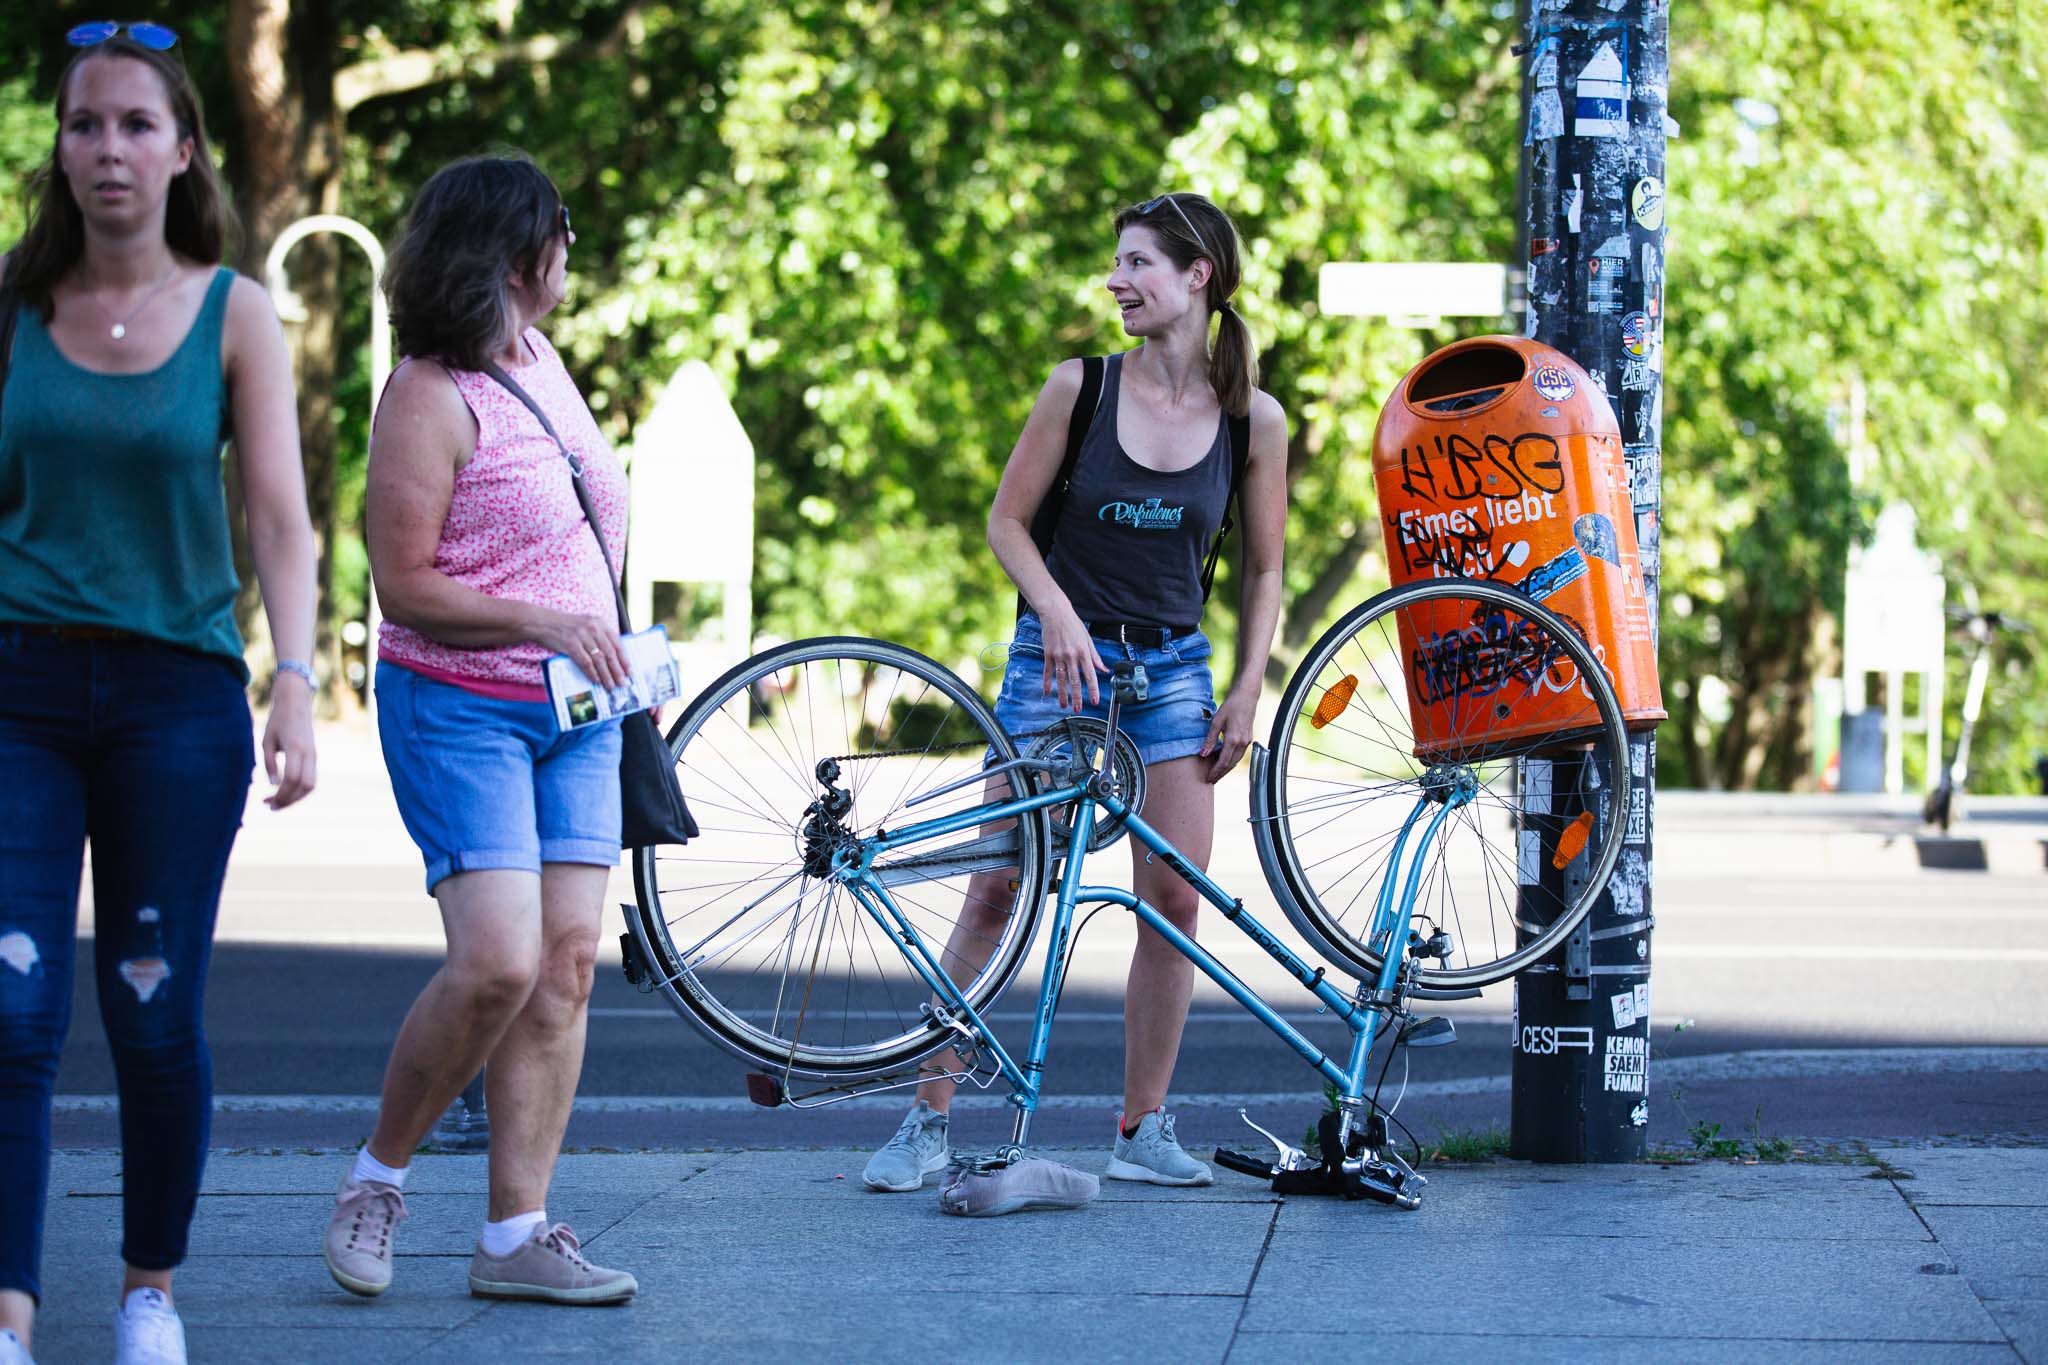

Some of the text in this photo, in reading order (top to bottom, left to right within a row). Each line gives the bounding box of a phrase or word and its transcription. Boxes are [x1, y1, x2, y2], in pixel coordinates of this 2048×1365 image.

[1601, 258, 1624, 266] HIER
[1540, 369, 1568, 386] CSC
[1400, 506, 1479, 545] Eimer
[1484, 489, 1558, 529] liebt
[1250, 927, 1290, 962] PUCH
[1606, 1035, 1645, 1055] KEMOR
[1609, 1055, 1642, 1073] SAEM
[1603, 1073, 1643, 1092] FUMAR
